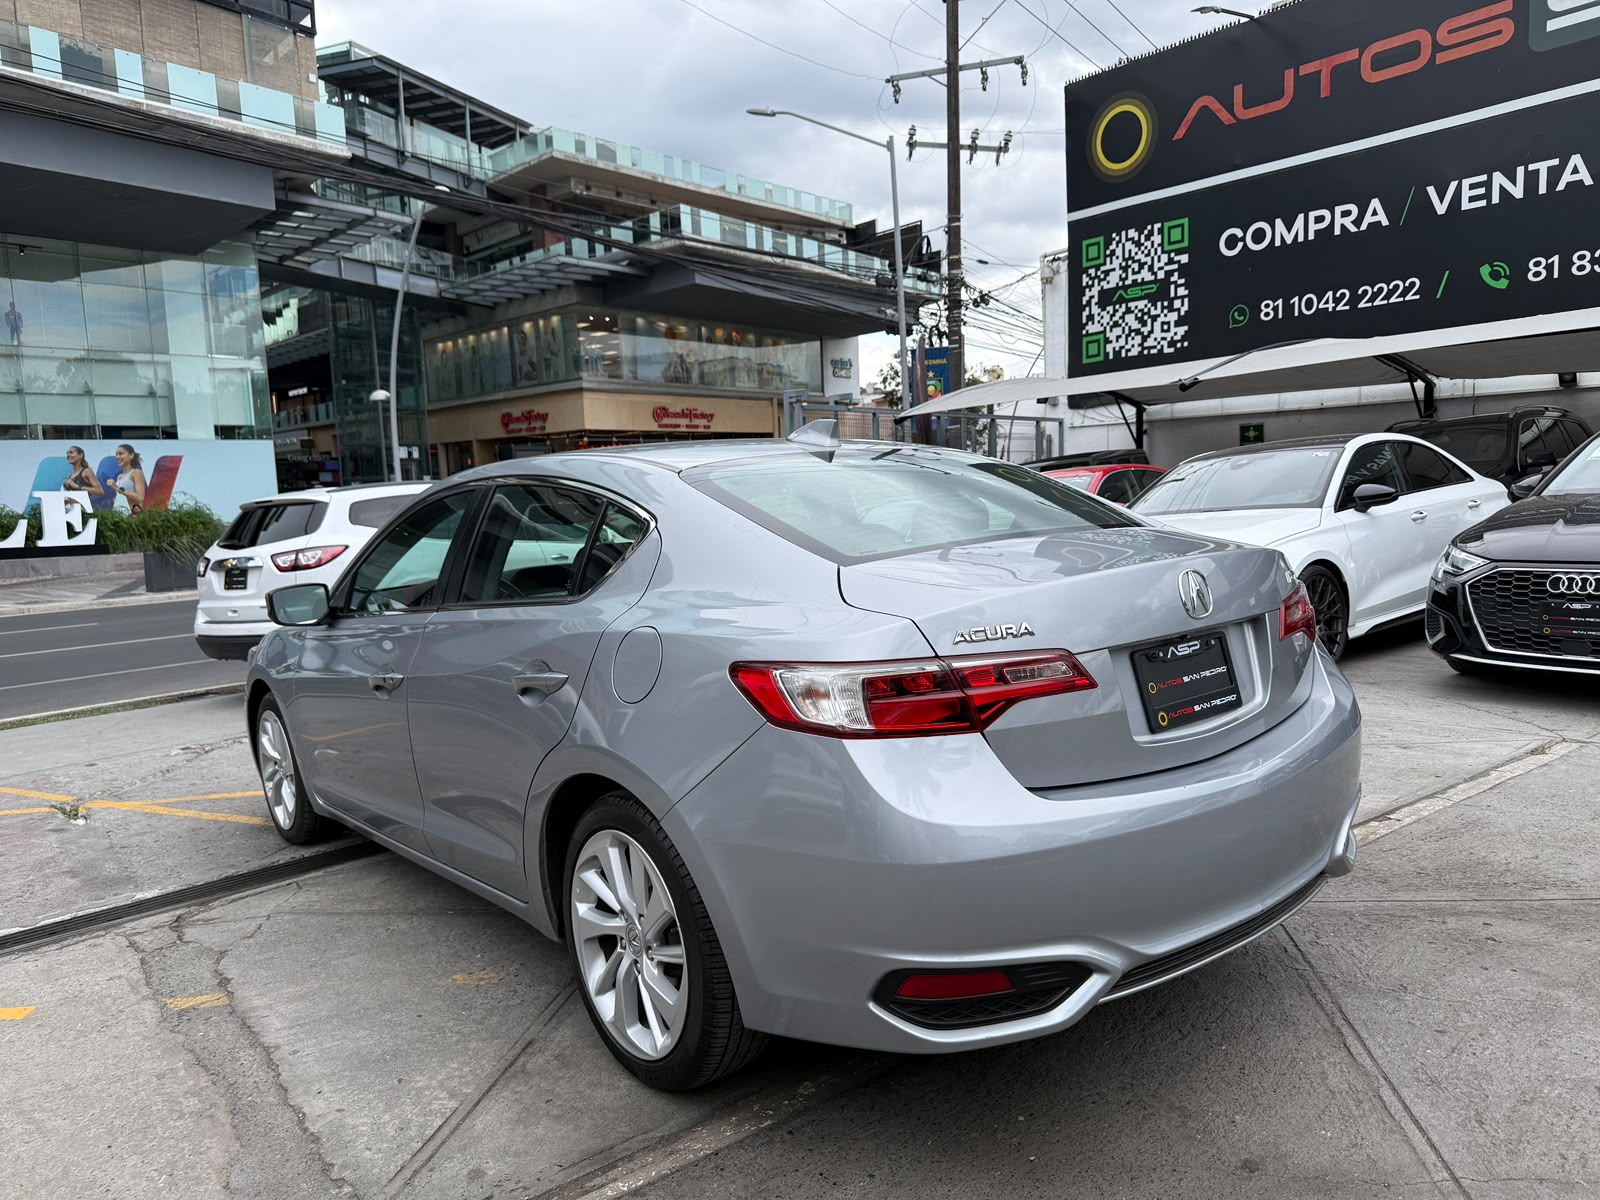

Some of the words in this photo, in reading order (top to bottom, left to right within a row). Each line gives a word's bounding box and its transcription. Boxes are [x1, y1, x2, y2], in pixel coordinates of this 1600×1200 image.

[1172, 0, 1515, 140] AUTOS
[1218, 198, 1389, 257] COMPRA
[1426, 153, 1594, 215] VENTA
[1112, 283, 1158, 301] ASP
[1259, 299, 1284, 321] 81
[1289, 288, 1350, 316] 1042
[1357, 277, 1421, 309] 2222
[1527, 254, 1560, 282] 81
[953, 622, 1035, 645] ACURA
[1167, 640, 1201, 658] ASP
[1157, 678, 1183, 689] AUTOS
[1183, 673, 1200, 682] SAN
[1200, 666, 1227, 678] PEDRO
[1169, 707, 1194, 719] AUTOS
[1194, 702, 1211, 711] SAN
[1211, 694, 1237, 706] PEDRO
